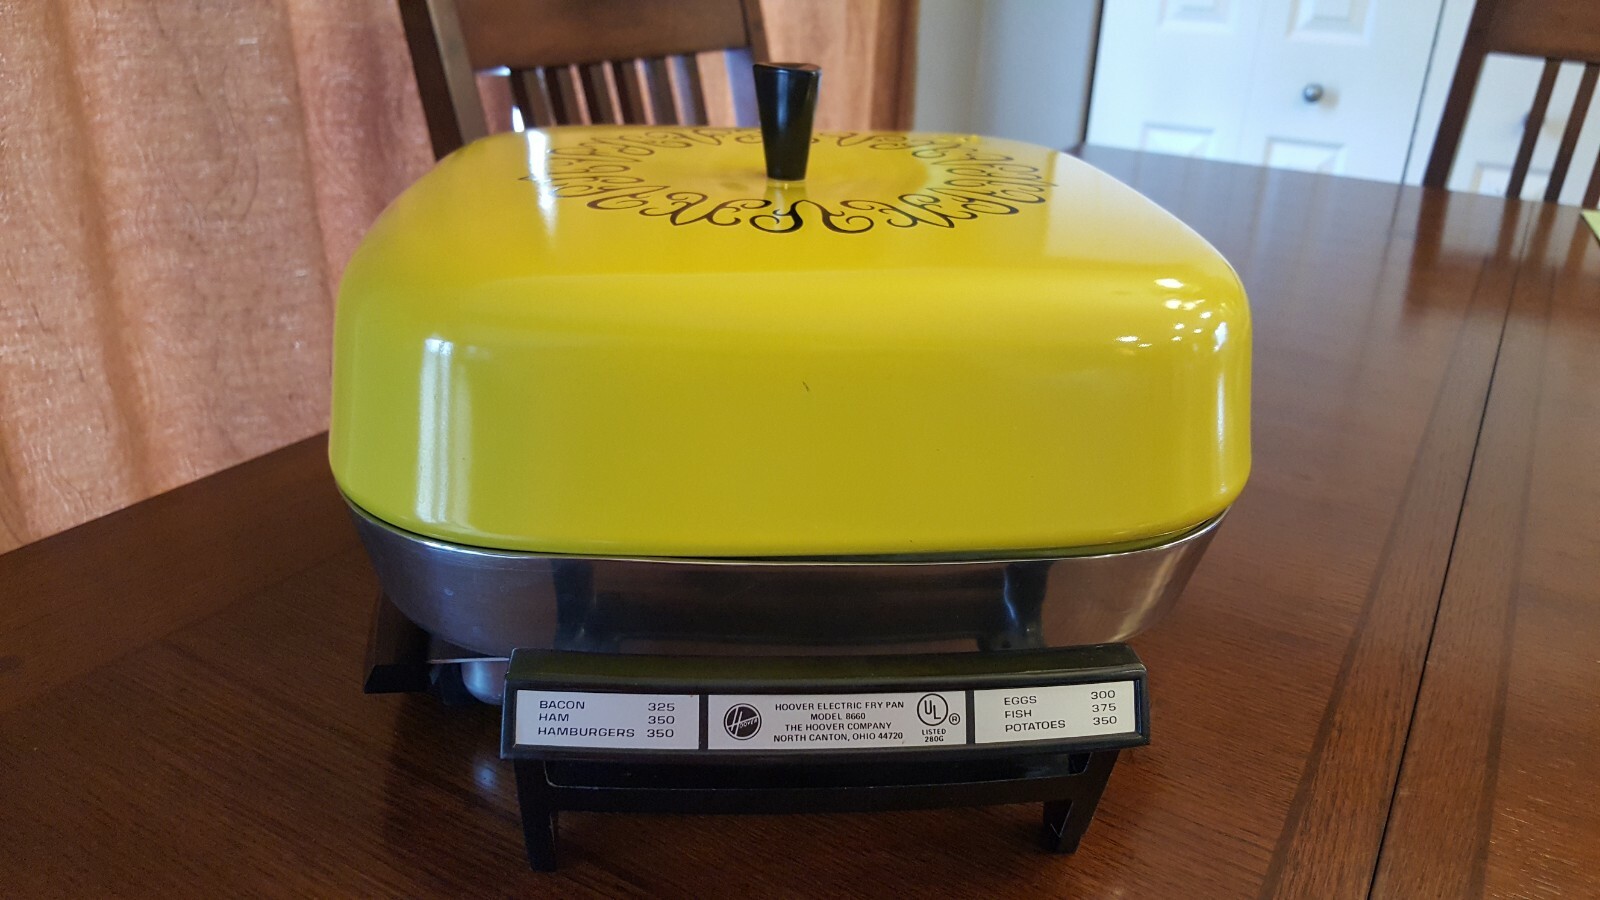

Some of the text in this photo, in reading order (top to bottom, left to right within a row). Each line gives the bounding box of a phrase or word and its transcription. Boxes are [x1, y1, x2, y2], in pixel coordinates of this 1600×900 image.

[1004, 690, 1116, 706] EGGS 300
[539, 700, 675, 712] BACON 325
[775, 701, 904, 711] HOOVER ELECTRIC FRY PAN
[923, 699, 942, 720] UL
[1004, 703, 1117, 719] FISH 375
[538, 713, 675, 725] HAM 350
[810, 712, 866, 721] MODEL 8660
[785, 722, 892, 732] THE HOOVER COMPANY
[1005, 715, 1118, 733] POTATOES 350
[537, 726, 674, 738] HAMBURGERS 350
[773, 732, 903, 743] NORTH CANTON, OHIO 44720
[921, 728, 947, 736] LISTED
[924, 735, 944, 743] 280G
